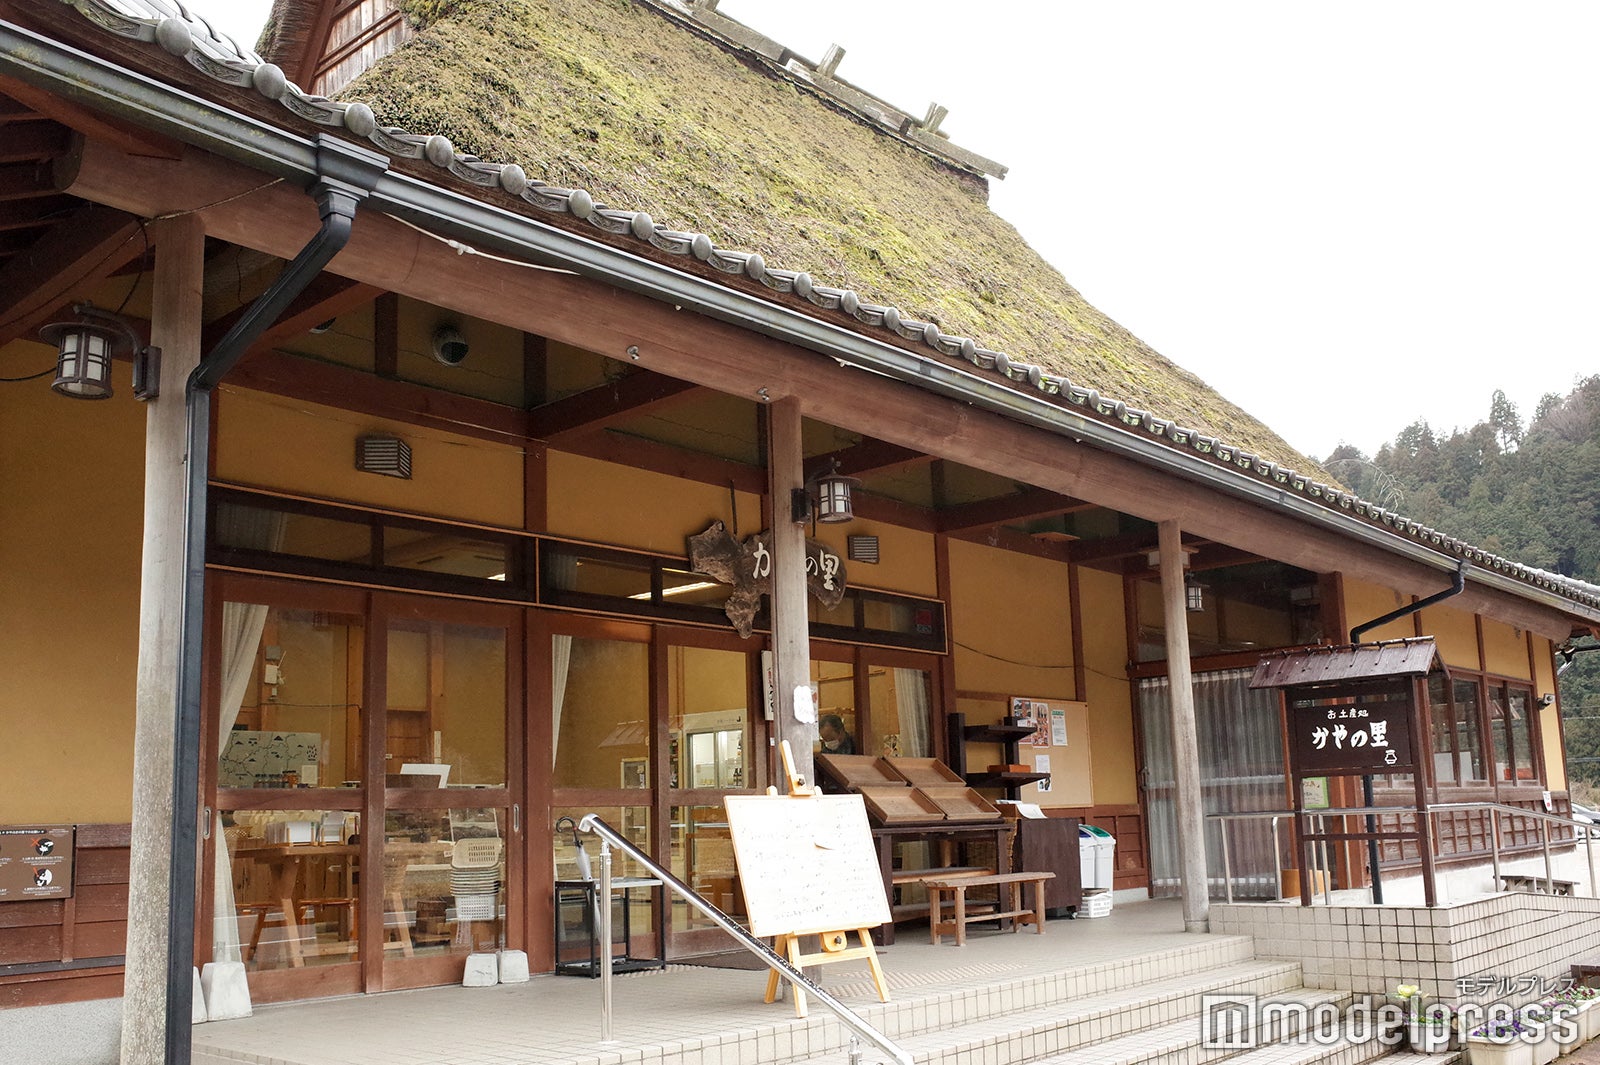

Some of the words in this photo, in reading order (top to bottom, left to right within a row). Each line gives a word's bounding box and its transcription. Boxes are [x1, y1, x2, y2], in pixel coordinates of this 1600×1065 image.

[1327, 708, 1369, 719] お土産処
[1312, 720, 1389, 749] かやの里
